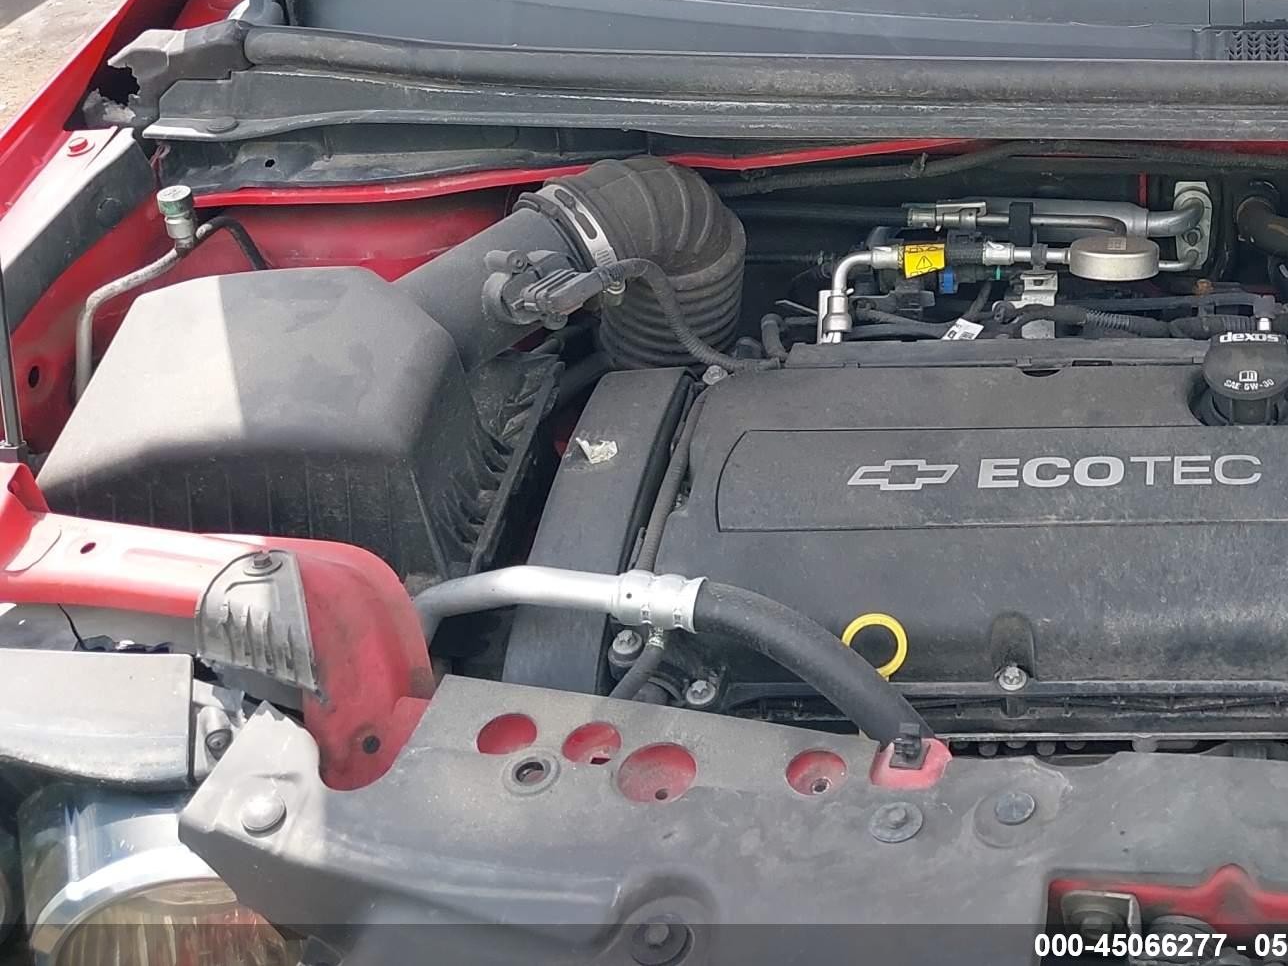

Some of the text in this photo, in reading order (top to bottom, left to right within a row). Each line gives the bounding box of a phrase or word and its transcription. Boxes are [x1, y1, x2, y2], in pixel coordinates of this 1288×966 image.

[1219, 332, 1279, 343] dexos
[1223, 378, 1275, 391] SAE 5W-30
[977, 454, 1262, 488] ECOTEC
